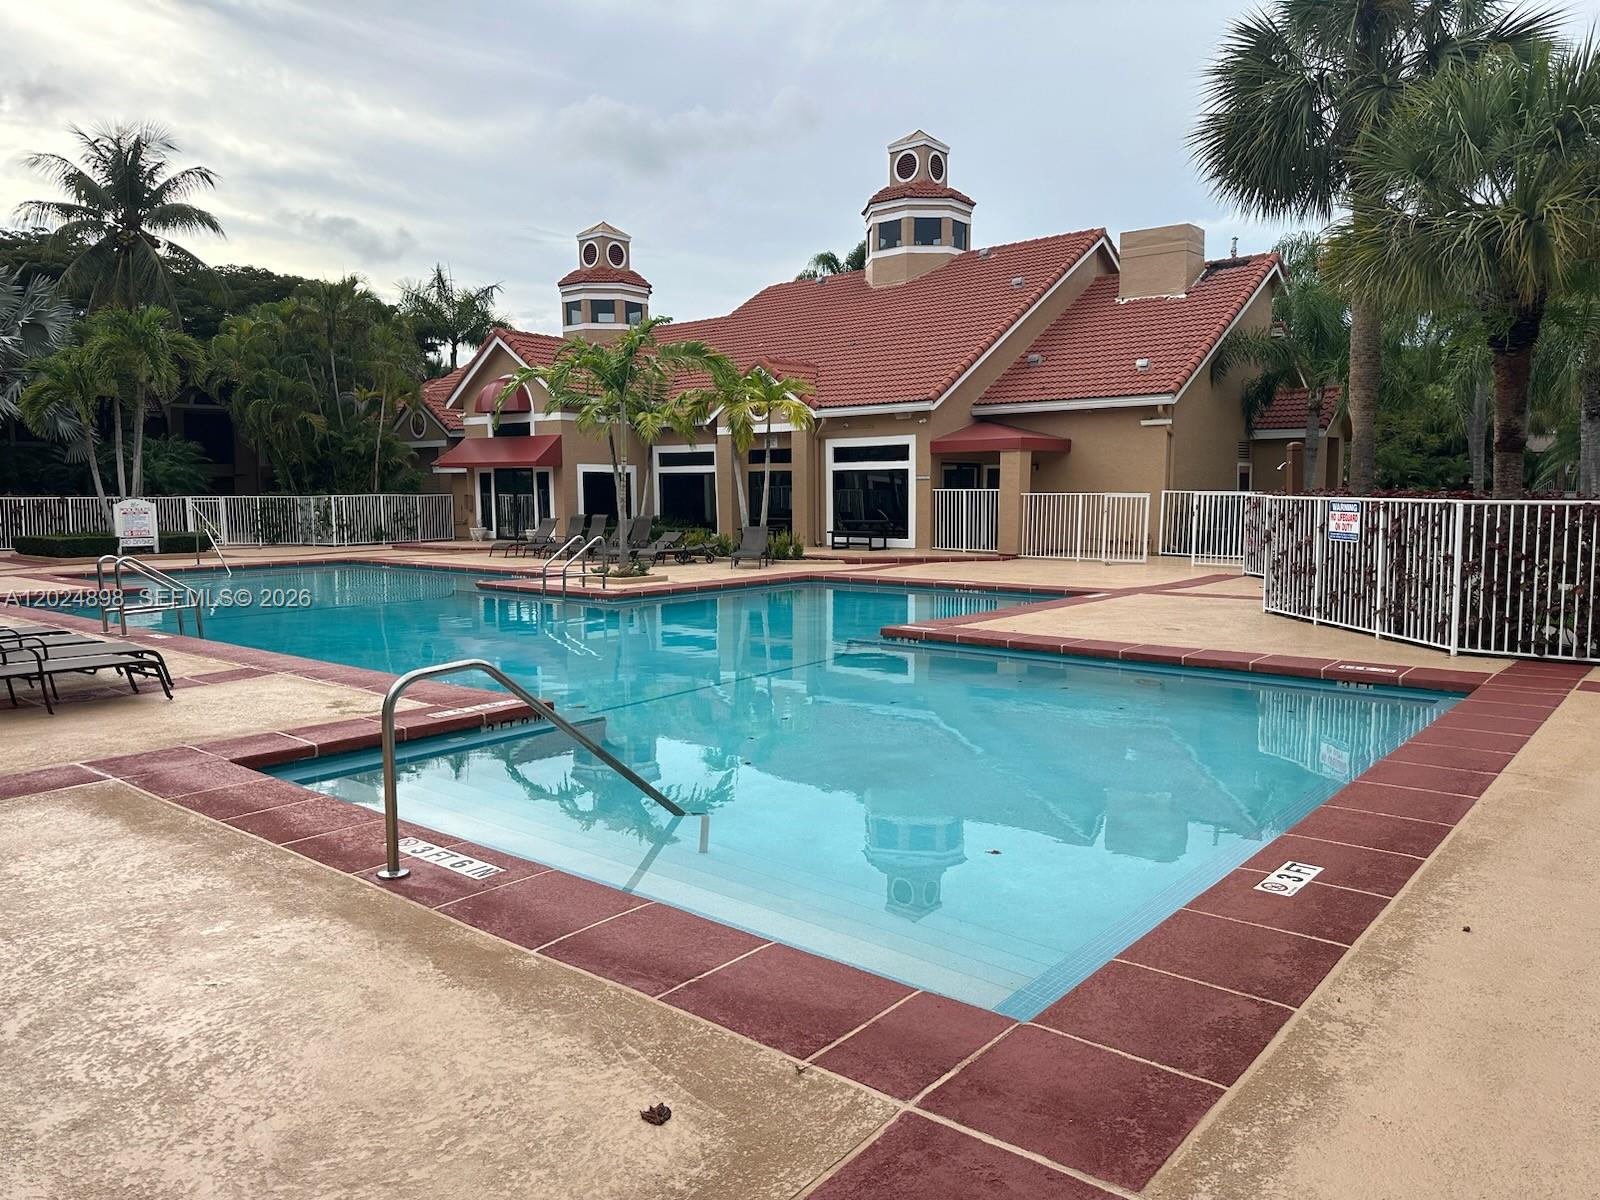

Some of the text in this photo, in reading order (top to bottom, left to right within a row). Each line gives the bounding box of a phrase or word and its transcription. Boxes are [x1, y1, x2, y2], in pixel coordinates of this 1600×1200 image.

[1332, 503, 1358, 511] WARNING
[1331, 512, 1358, 522] NO LIFEGUARD
[1335, 522, 1353, 531] ON DUTY
[410, 846, 500, 878] 3 FT 6 IN
[1276, 863, 1317, 882] 3 FT
